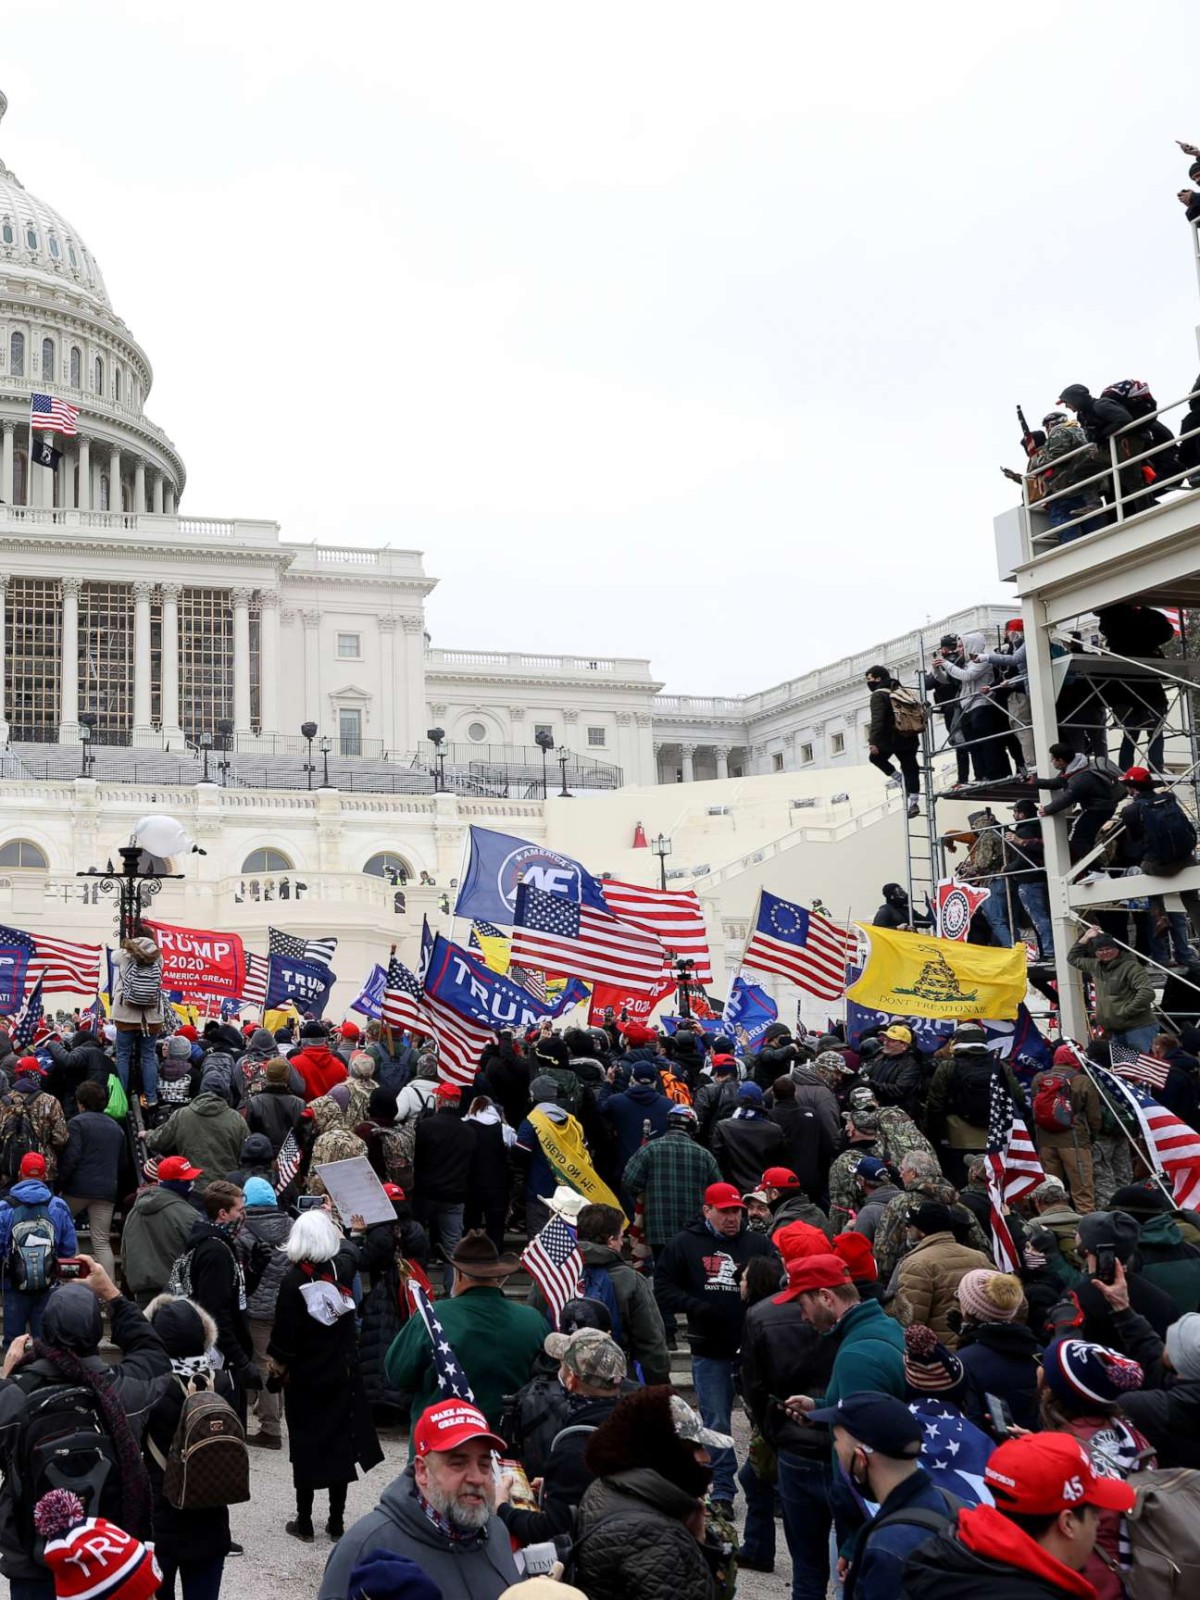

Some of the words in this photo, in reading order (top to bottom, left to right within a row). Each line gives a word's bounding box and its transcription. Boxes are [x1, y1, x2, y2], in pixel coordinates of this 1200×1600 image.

[163, 971, 200, 981] AMERICA
[202, 974, 233, 986] GREAT!
[915, 1001, 948, 1013] TREAD
[949, 1004, 969, 1014] ON
[972, 1005, 988, 1014] ME
[430, 1408, 455, 1423] MAKE
[1062, 1475, 1085, 1501] 45
